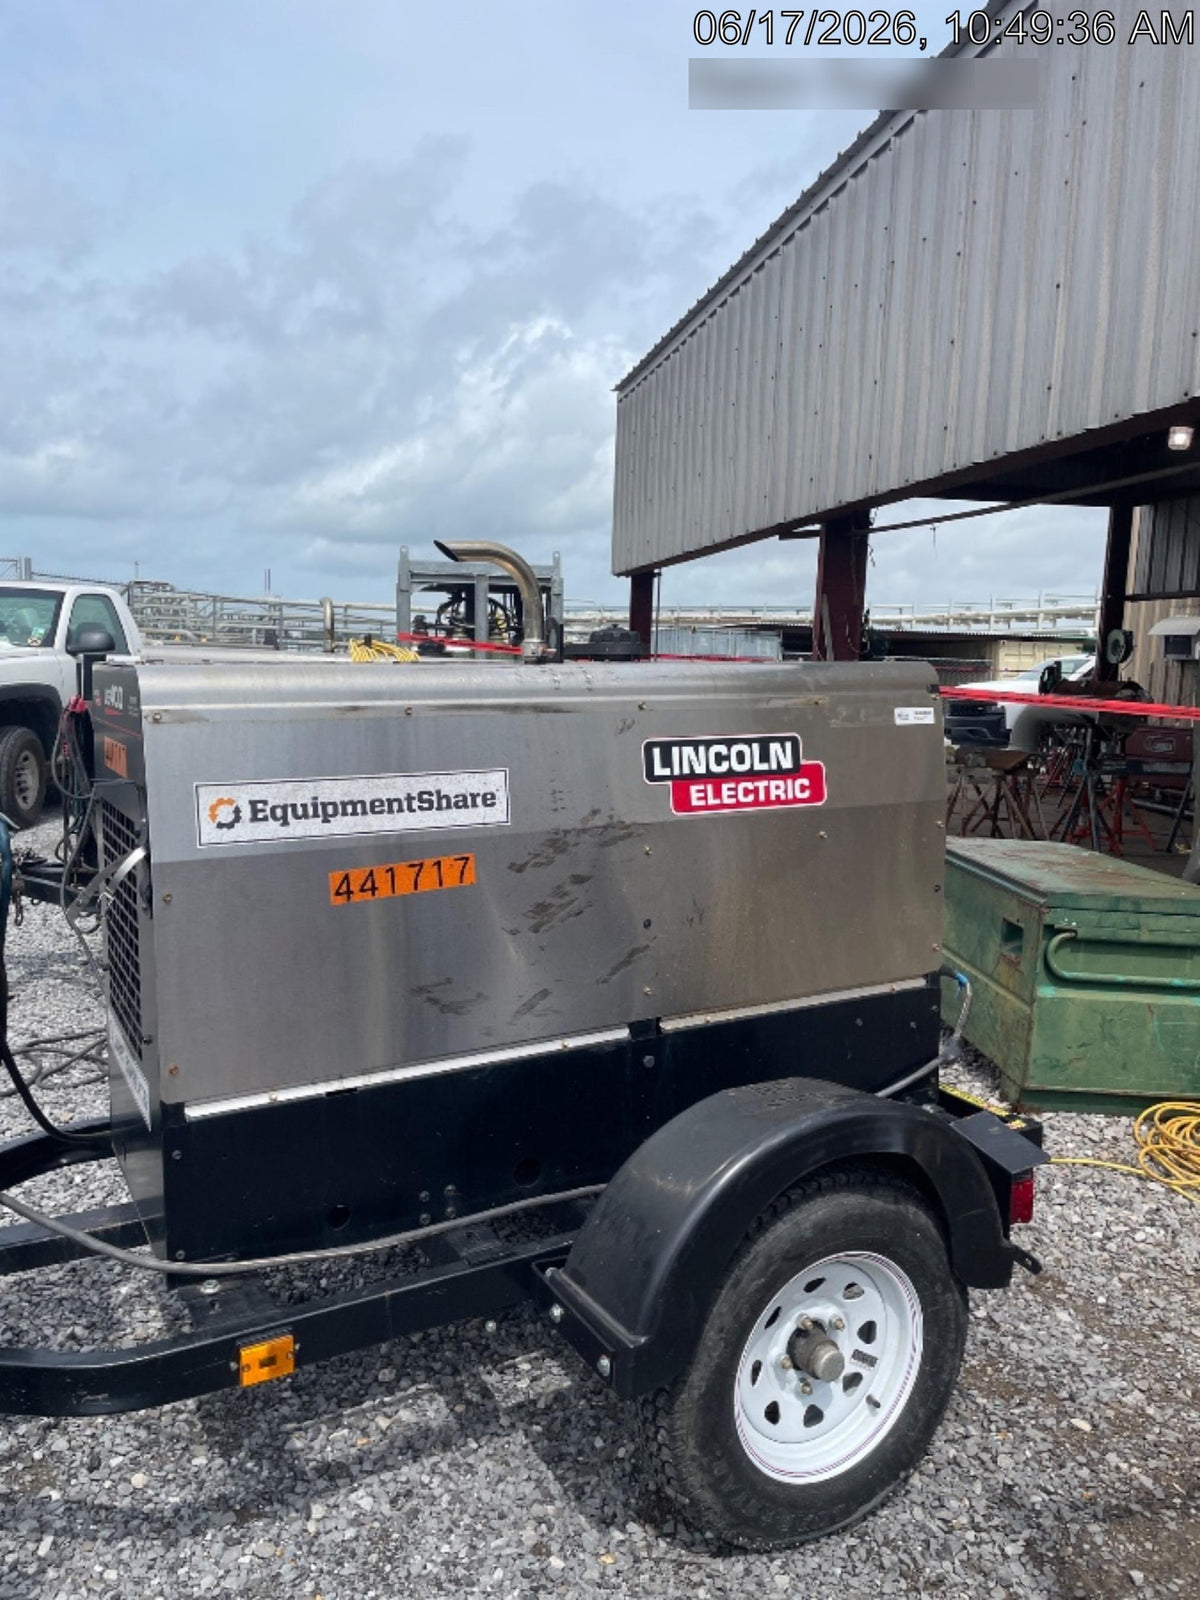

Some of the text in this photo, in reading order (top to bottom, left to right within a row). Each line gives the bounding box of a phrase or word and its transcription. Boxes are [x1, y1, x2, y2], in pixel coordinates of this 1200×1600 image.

[652, 741, 793, 776] LINCOLN
[248, 789, 497, 826] EquipmentShare
[690, 778, 810, 806] ELECTRIC
[334, 856, 470, 901] 441717
